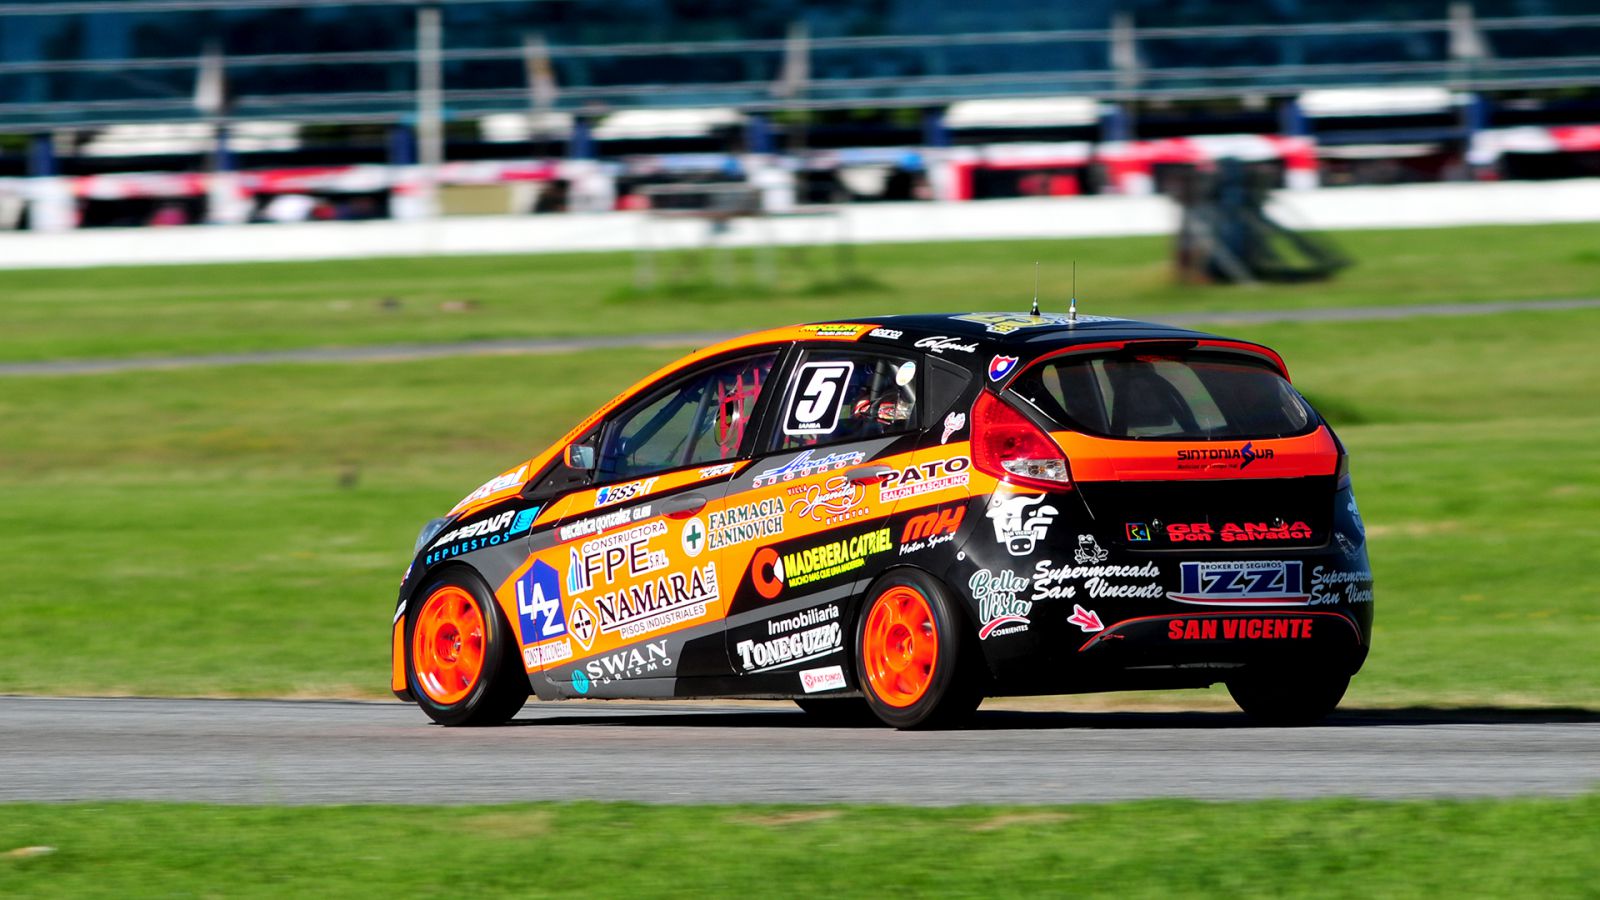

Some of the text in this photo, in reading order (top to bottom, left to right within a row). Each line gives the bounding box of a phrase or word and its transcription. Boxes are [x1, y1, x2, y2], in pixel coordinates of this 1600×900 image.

[795, 368, 845, 422] 5
[753, 457, 863, 488] SEGUROS
[878, 458, 969, 488] PATO
[882, 476, 968, 500] SALON MASCULINO
[788, 485, 807, 496] VILLA
[709, 498, 784, 530] FARMACIA
[901, 505, 966, 543] MH
[426, 531, 510, 565] REPUESTOS
[583, 522, 666, 554] CONSTRUCTORA
[709, 516, 783, 549] ZANINOVICH
[899, 532, 956, 555] Motor Sport
[1169, 530, 1312, 542] Don Salvador
[585, 539, 649, 587] FPE
[784, 540, 849, 578] MADERERA
[1032, 560, 1160, 584] Supermercado
[969, 569, 1030, 599] Bella
[1032, 577, 1163, 600] San Vincente
[1180, 561, 1303, 594] IZZI
[517, 580, 565, 636] LAZ
[595, 570, 708, 626] NAMARA
[979, 592, 1033, 624] Vista
[1310, 584, 1340, 605] San
[621, 604, 705, 635] PISOS INDUSTRIALES
[768, 604, 840, 635] Inmobiliaria
[991, 624, 1029, 637] CORRIENTES
[1168, 619, 1313, 639] SAN VICENTE
[587, 640, 667, 681] SWAN
[592, 658, 672, 687] TURISMO
